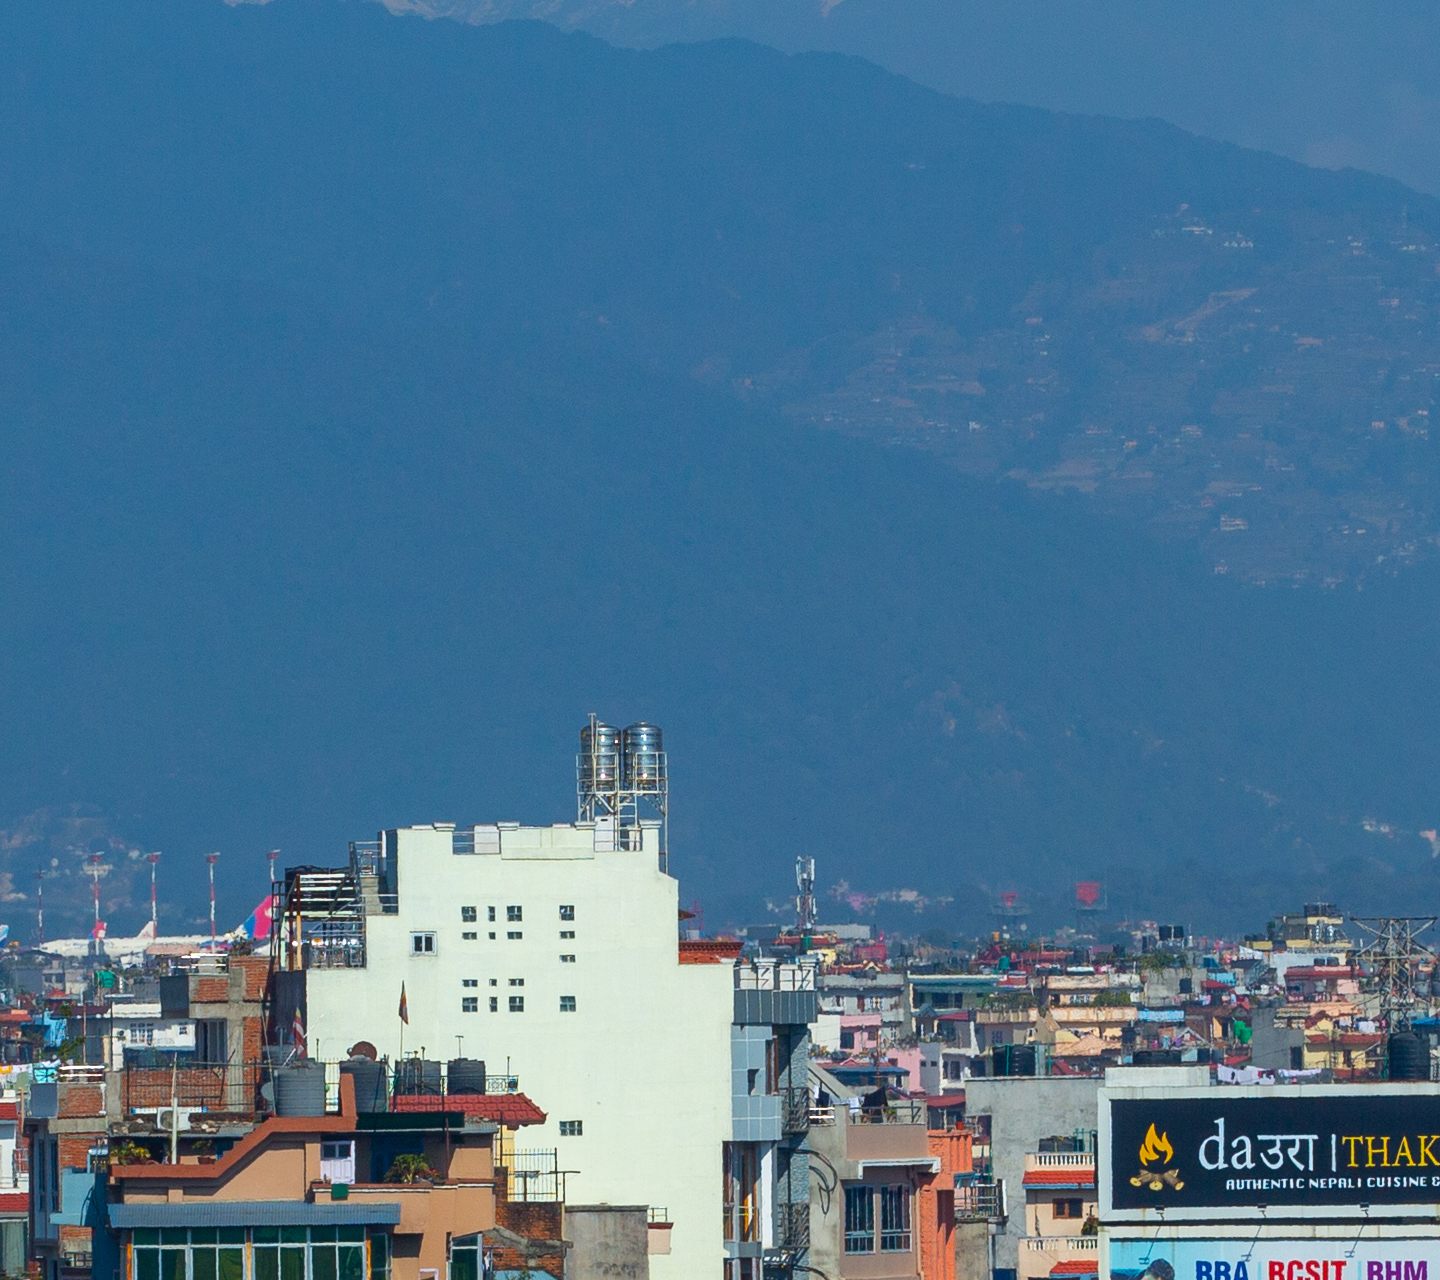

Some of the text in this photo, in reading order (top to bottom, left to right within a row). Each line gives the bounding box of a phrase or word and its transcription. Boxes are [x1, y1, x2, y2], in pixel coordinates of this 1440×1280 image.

[1226, 1178, 1305, 1190] AUTHENTIC
[1309, 1177, 1362, 1189] NEPALI
[1367, 1176, 1427, 1188] CUISINE
